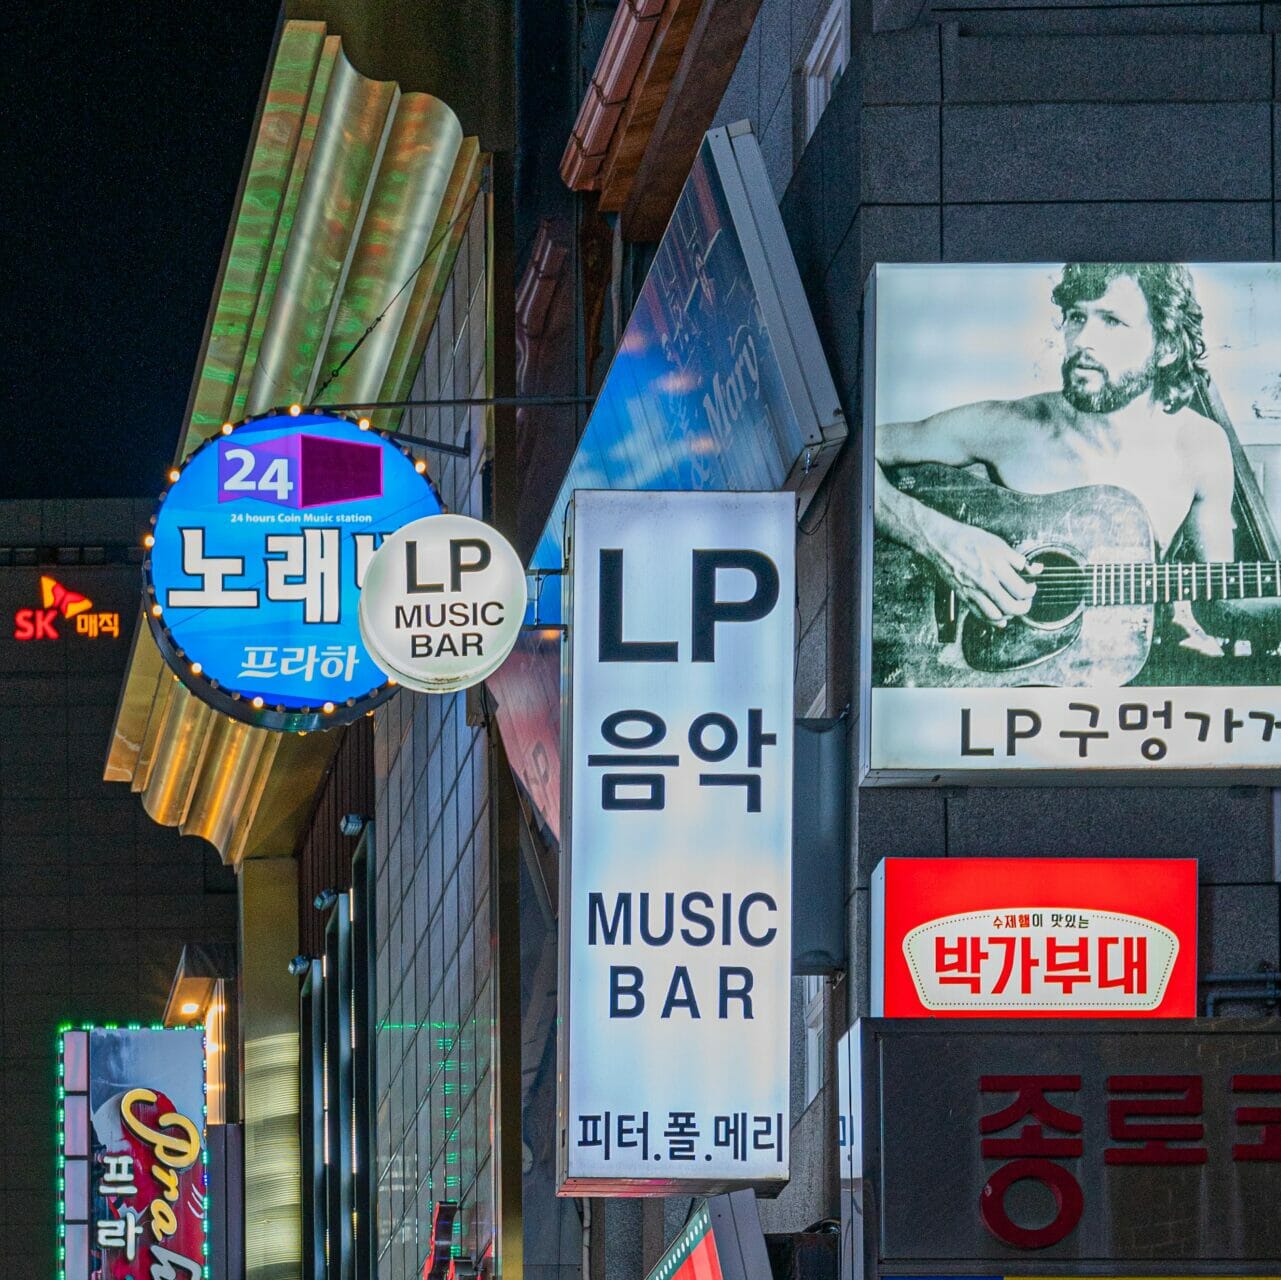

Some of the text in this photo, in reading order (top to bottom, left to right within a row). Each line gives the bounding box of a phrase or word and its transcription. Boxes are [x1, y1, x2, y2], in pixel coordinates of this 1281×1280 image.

[223, 448, 293, 500] 24
[231, 513, 372, 524] 24 hours Coin Music station
[406, 539, 491, 594] LP
[14, 609, 59, 640] SK
[77, 614, 119, 638] 매직
[395, 601, 505, 629] MUSIC
[598, 548, 780, 664] LP
[237, 645, 360, 682] 프라하
[411, 633, 484, 658] BAR
[960, 708, 1042, 758] LP
[588, 707, 778, 814] 음악
[588, 891, 780, 948] MUSIC
[993, 912, 1089, 930] 수제햄이 맛있는
[935, 936, 1147, 996] 박가부대
[609, 965, 757, 1020] BAR
[577, 1111, 785, 1165] 피터.폴.메리
